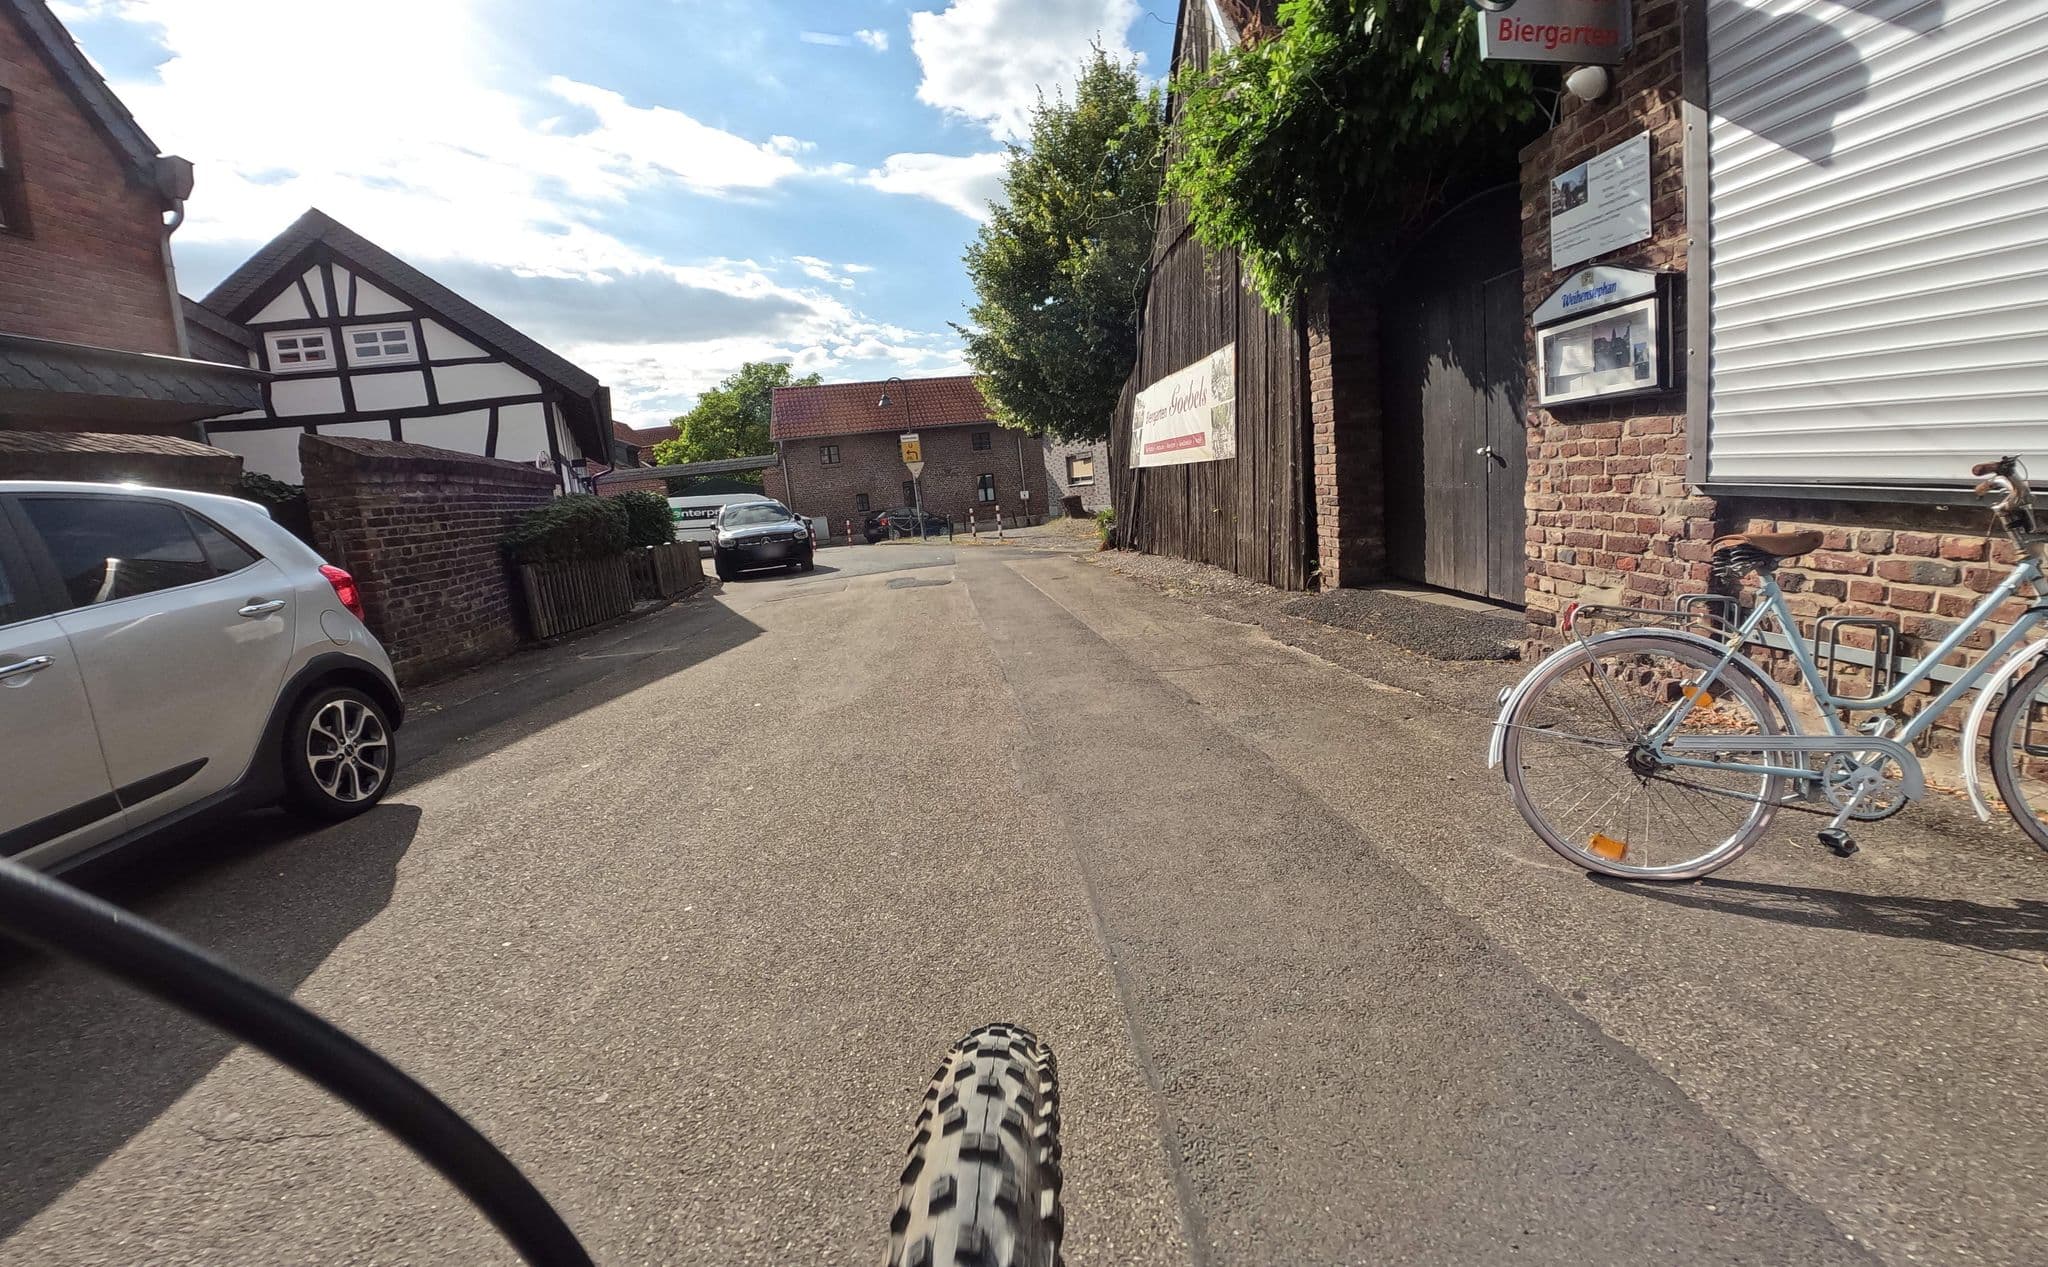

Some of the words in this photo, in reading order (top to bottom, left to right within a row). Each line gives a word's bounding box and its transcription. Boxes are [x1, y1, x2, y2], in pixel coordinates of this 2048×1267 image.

[1498, 17, 1618, 50] Biergarten
[1169, 376, 1208, 416] Goebels
[673, 509, 720, 518] enterpr
